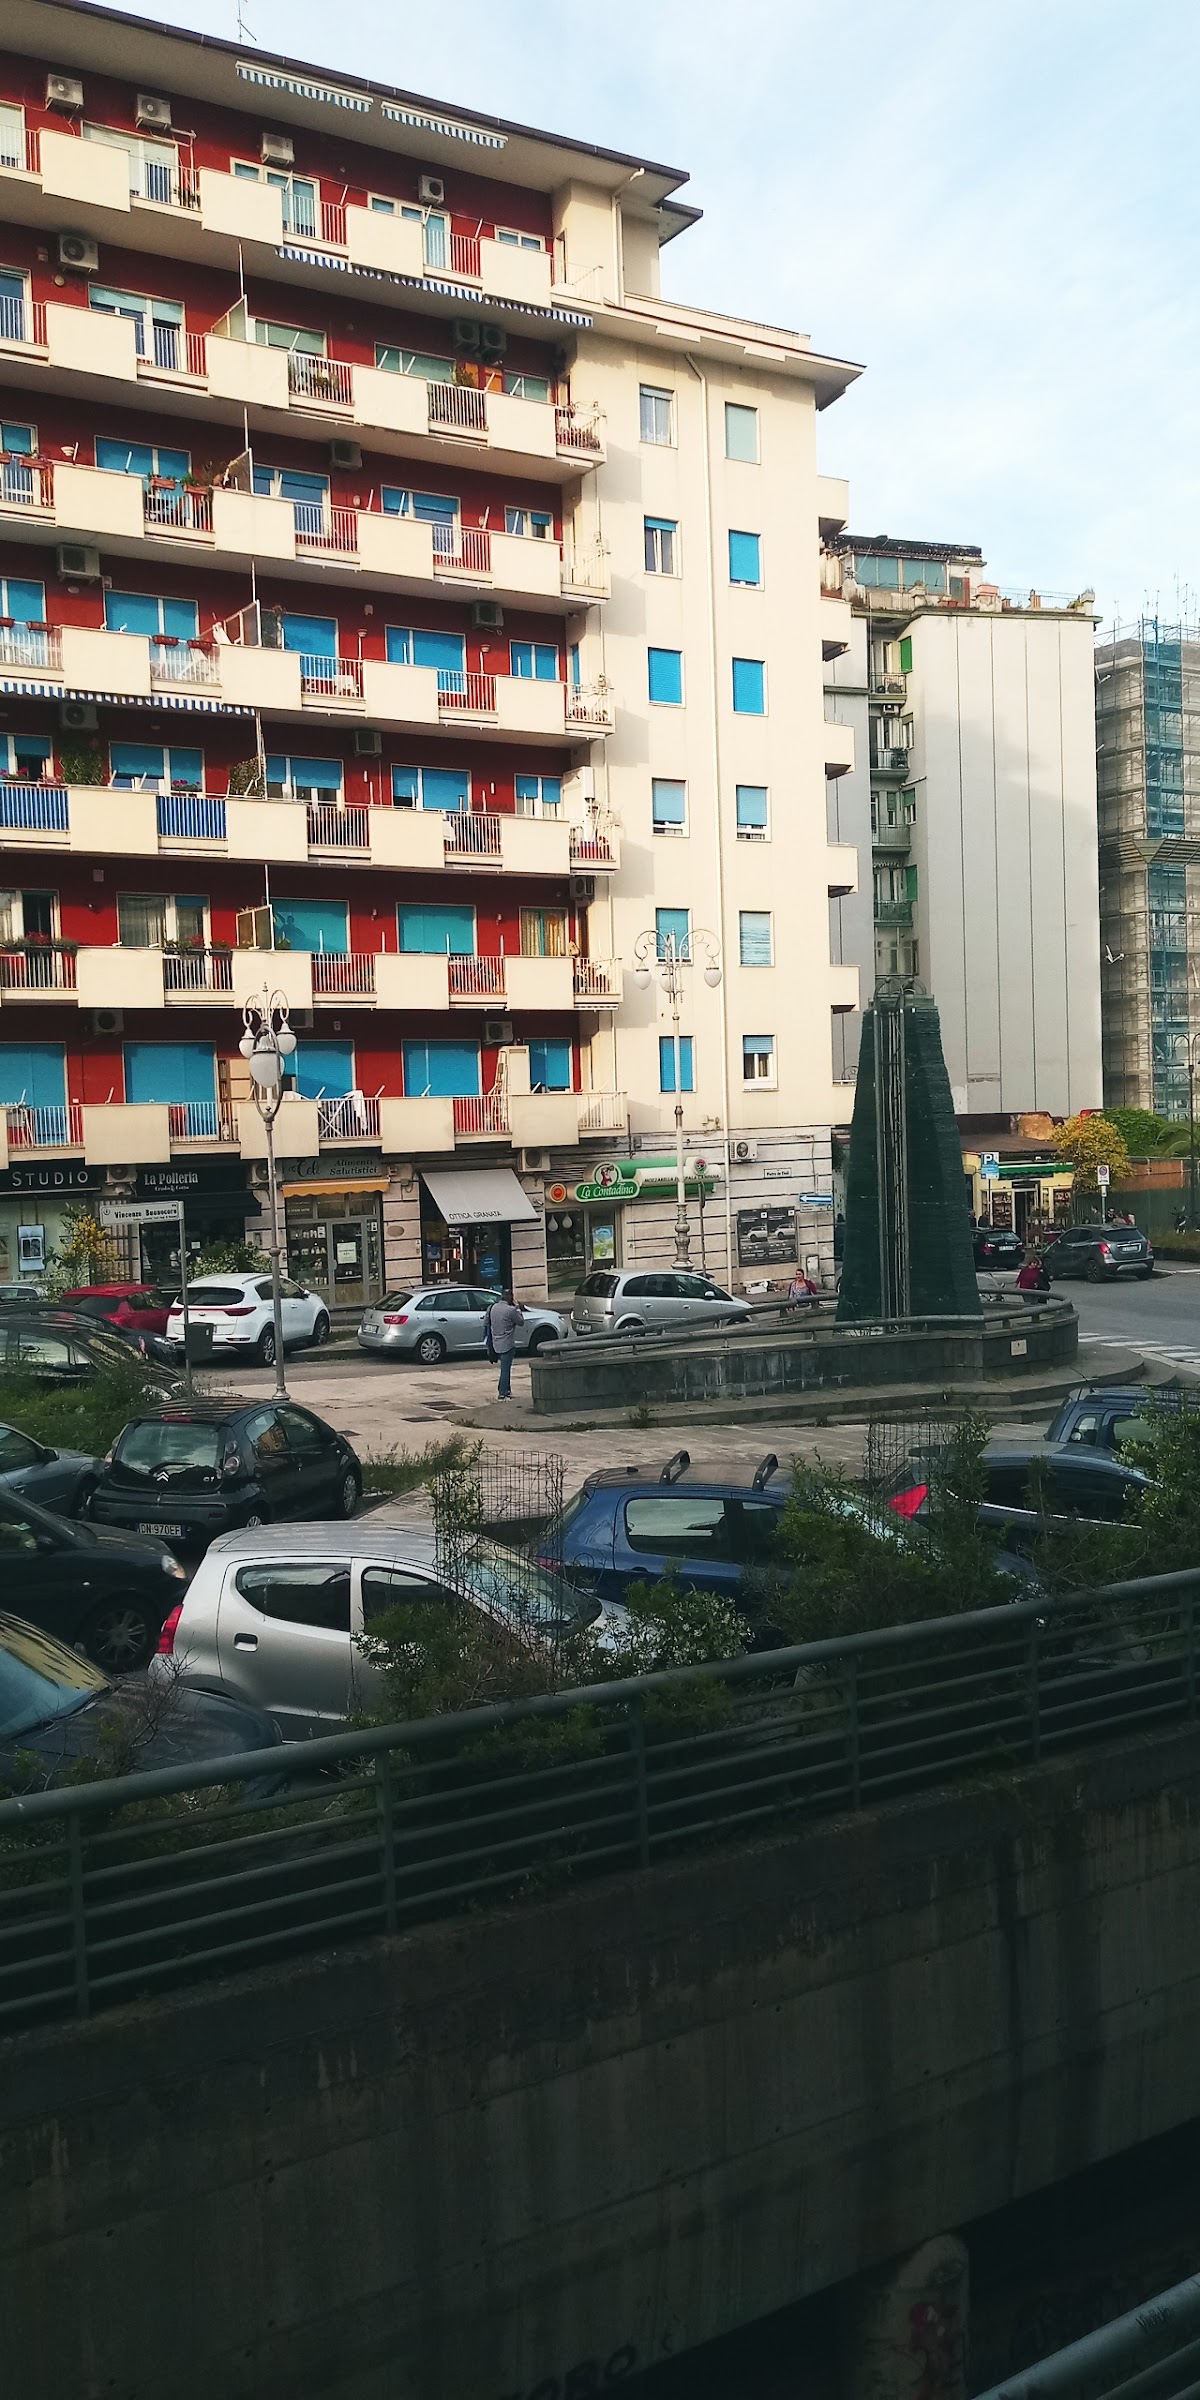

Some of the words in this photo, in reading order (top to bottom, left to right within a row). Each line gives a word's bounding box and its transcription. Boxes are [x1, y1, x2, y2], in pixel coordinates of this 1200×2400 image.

[335, 1159, 373, 1167] Alimenti
[984, 1154, 993, 1165] P
[330, 1165, 378, 1176] Salutistici
[12, 1171, 89, 1187] STUDIO
[144, 1174, 156, 1185] La
[159, 1172, 199, 1184] Polleria
[581, 1186, 591, 1199] La
[593, 1182, 634, 1197] Contadina
[114, 1211, 142, 1219] Vincenzo
[449, 1212, 472, 1220] OTTICA
[473, 1210, 502, 1218] GRANATA
[141, 1524, 151, 1534] DN
[154, 1525, 180, 1535] 970EF
